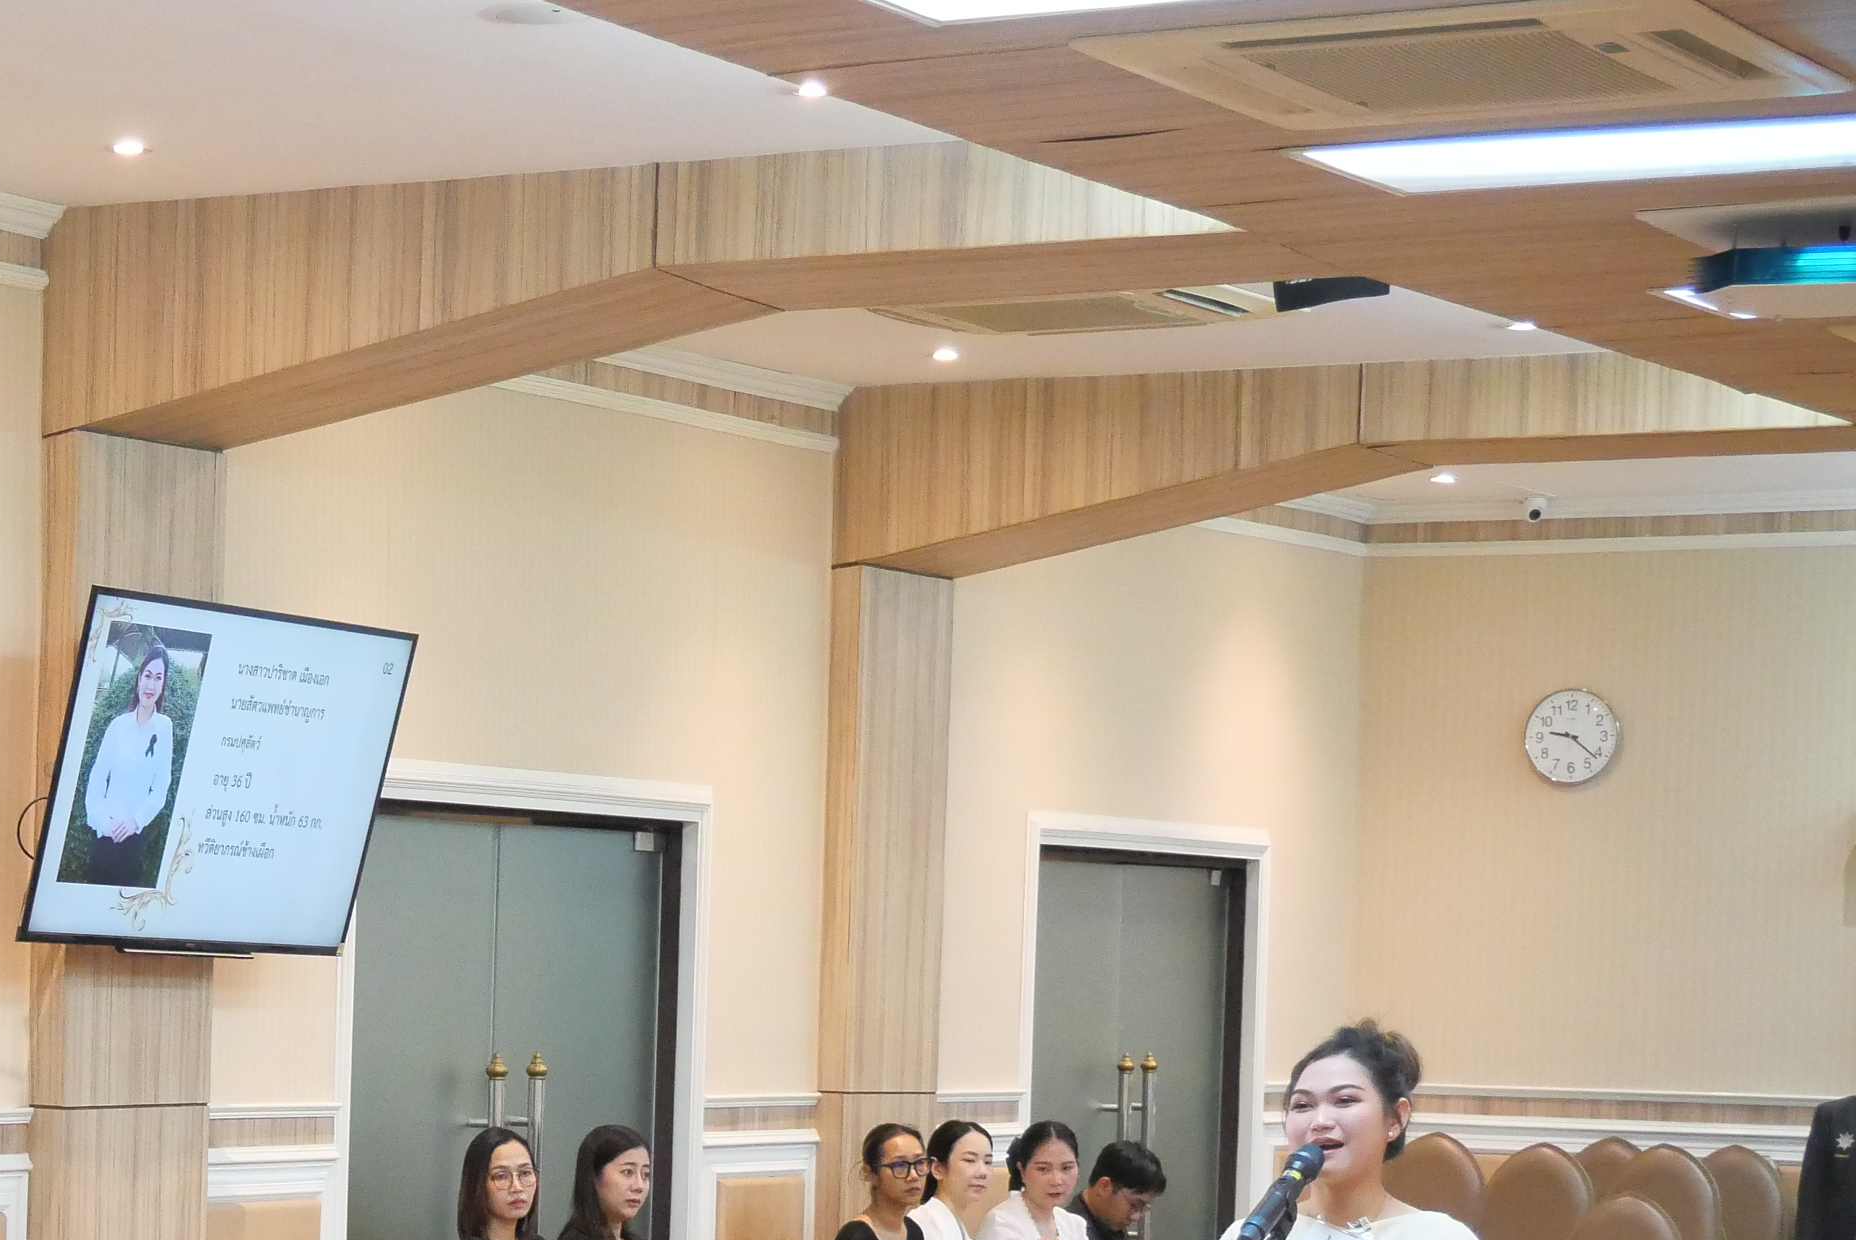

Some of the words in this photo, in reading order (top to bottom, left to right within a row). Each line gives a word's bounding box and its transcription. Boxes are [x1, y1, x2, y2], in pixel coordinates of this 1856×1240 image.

[382, 662, 394, 675] 02
[1551, 705, 1562, 715] 11
[1566, 700, 1578, 710] 12
[1540, 716, 1552, 727] 10
[1596, 715, 1604, 726] 2
[1536, 732, 1543, 743] 9
[1600, 731, 1608, 742] 3
[1541, 748, 1548, 759] 8
[1553, 759, 1560, 770] 7
[1567, 762, 1575, 773] 6
[1584, 758, 1591, 769] 5
[213, 773, 229, 791] อายุ
[230, 775, 243, 788] 36
[245, 772, 253, 789] ปี
[235, 810, 250, 823] 160
[297, 814, 309, 828] 63
